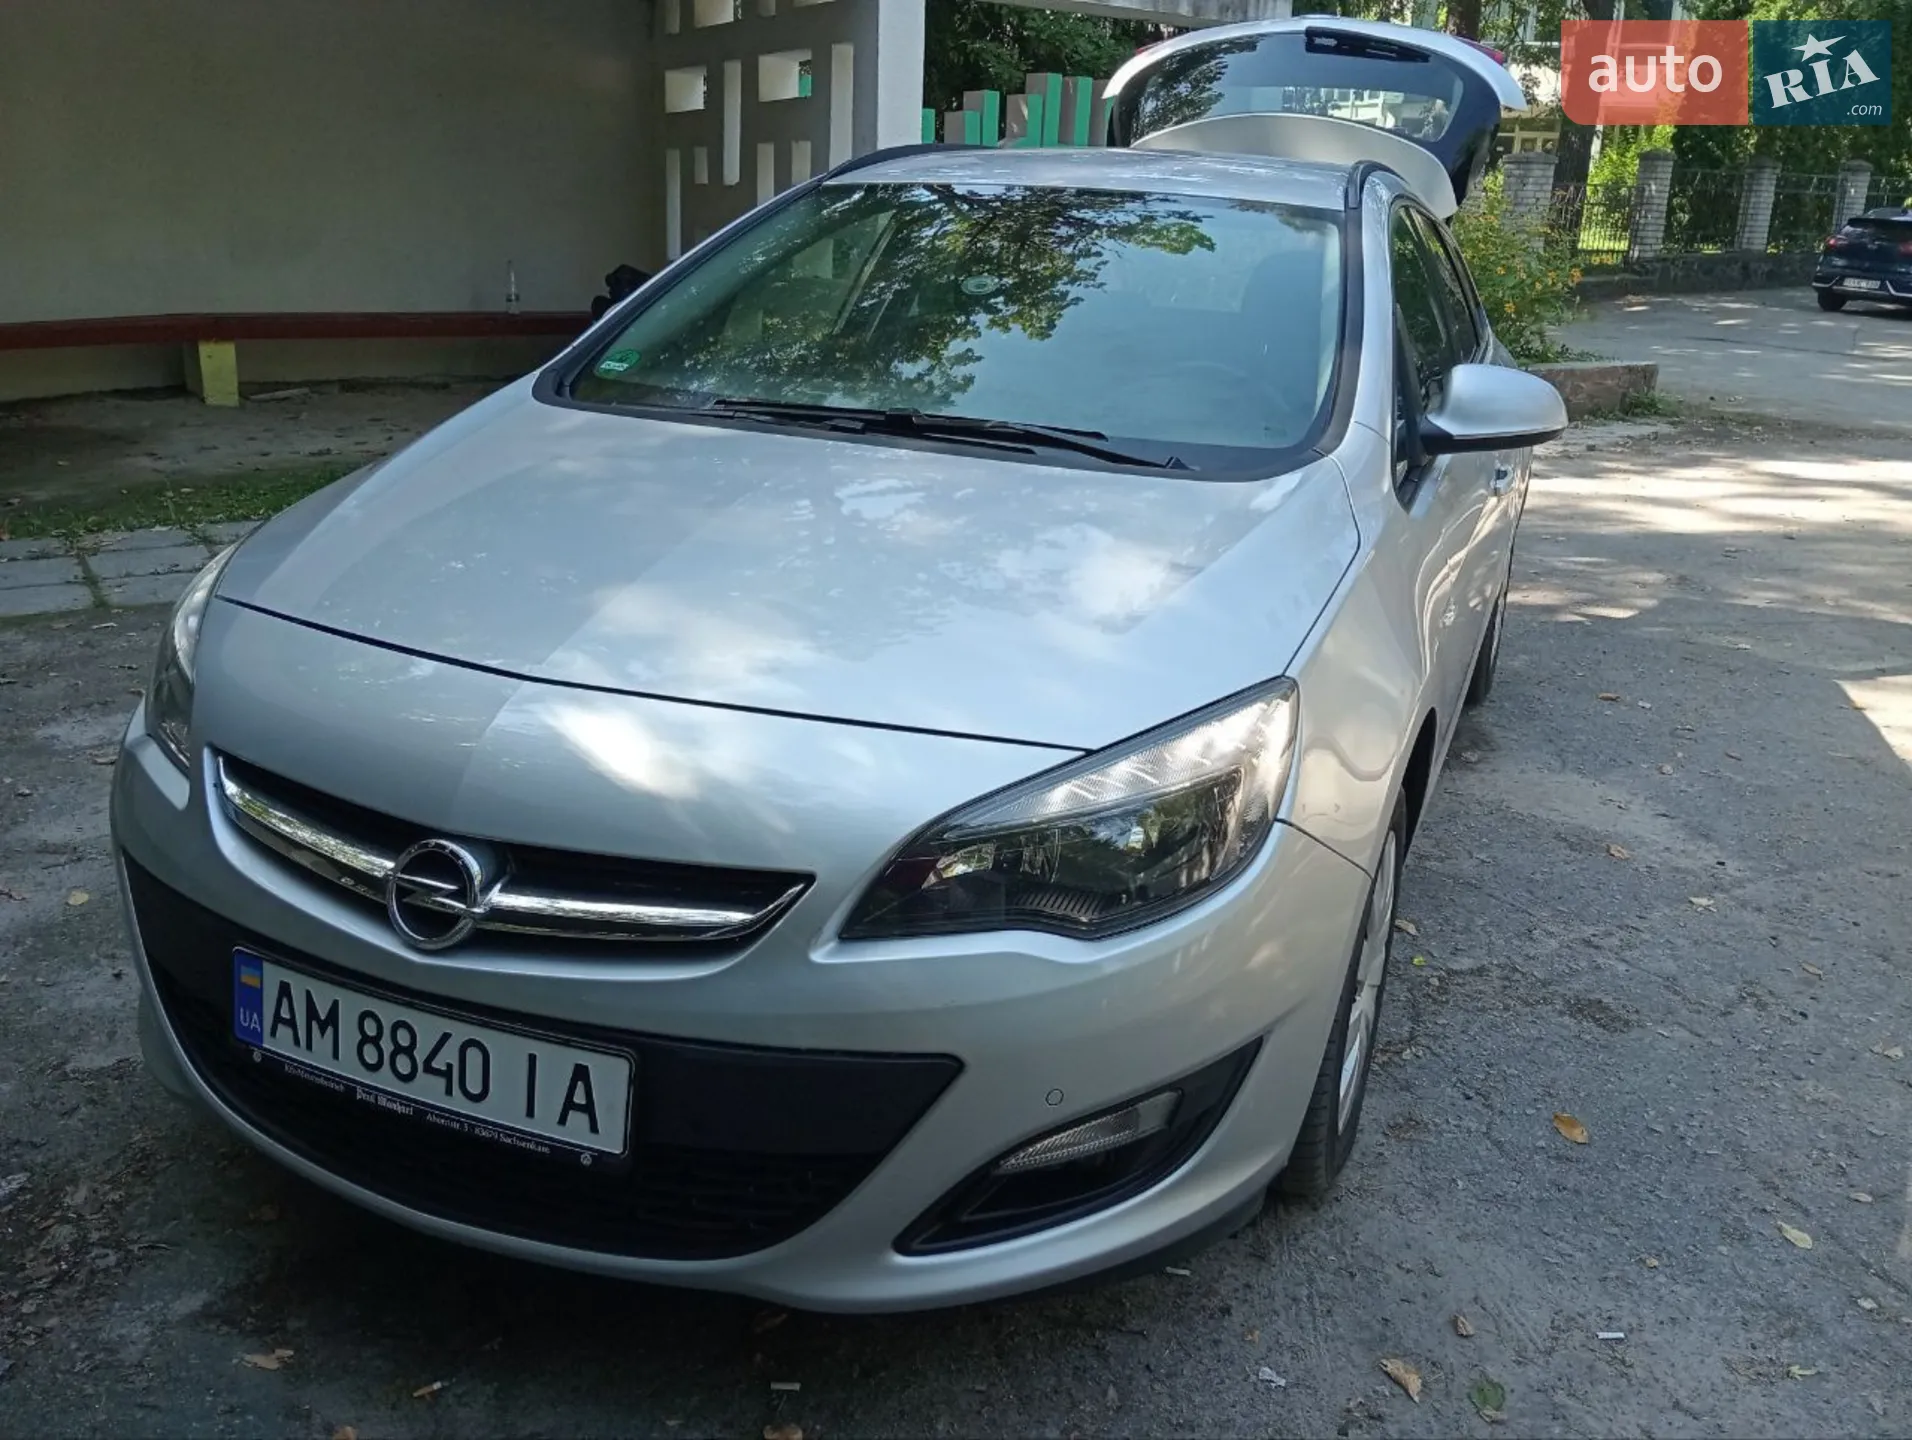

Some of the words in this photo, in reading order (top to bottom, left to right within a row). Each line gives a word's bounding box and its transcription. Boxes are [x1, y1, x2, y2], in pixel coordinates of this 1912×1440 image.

[239, 1007, 261, 1033] UA
[270, 979, 340, 1061] AM
[356, 1009, 491, 1104] 8840
[525, 1052, 600, 1134] IA
